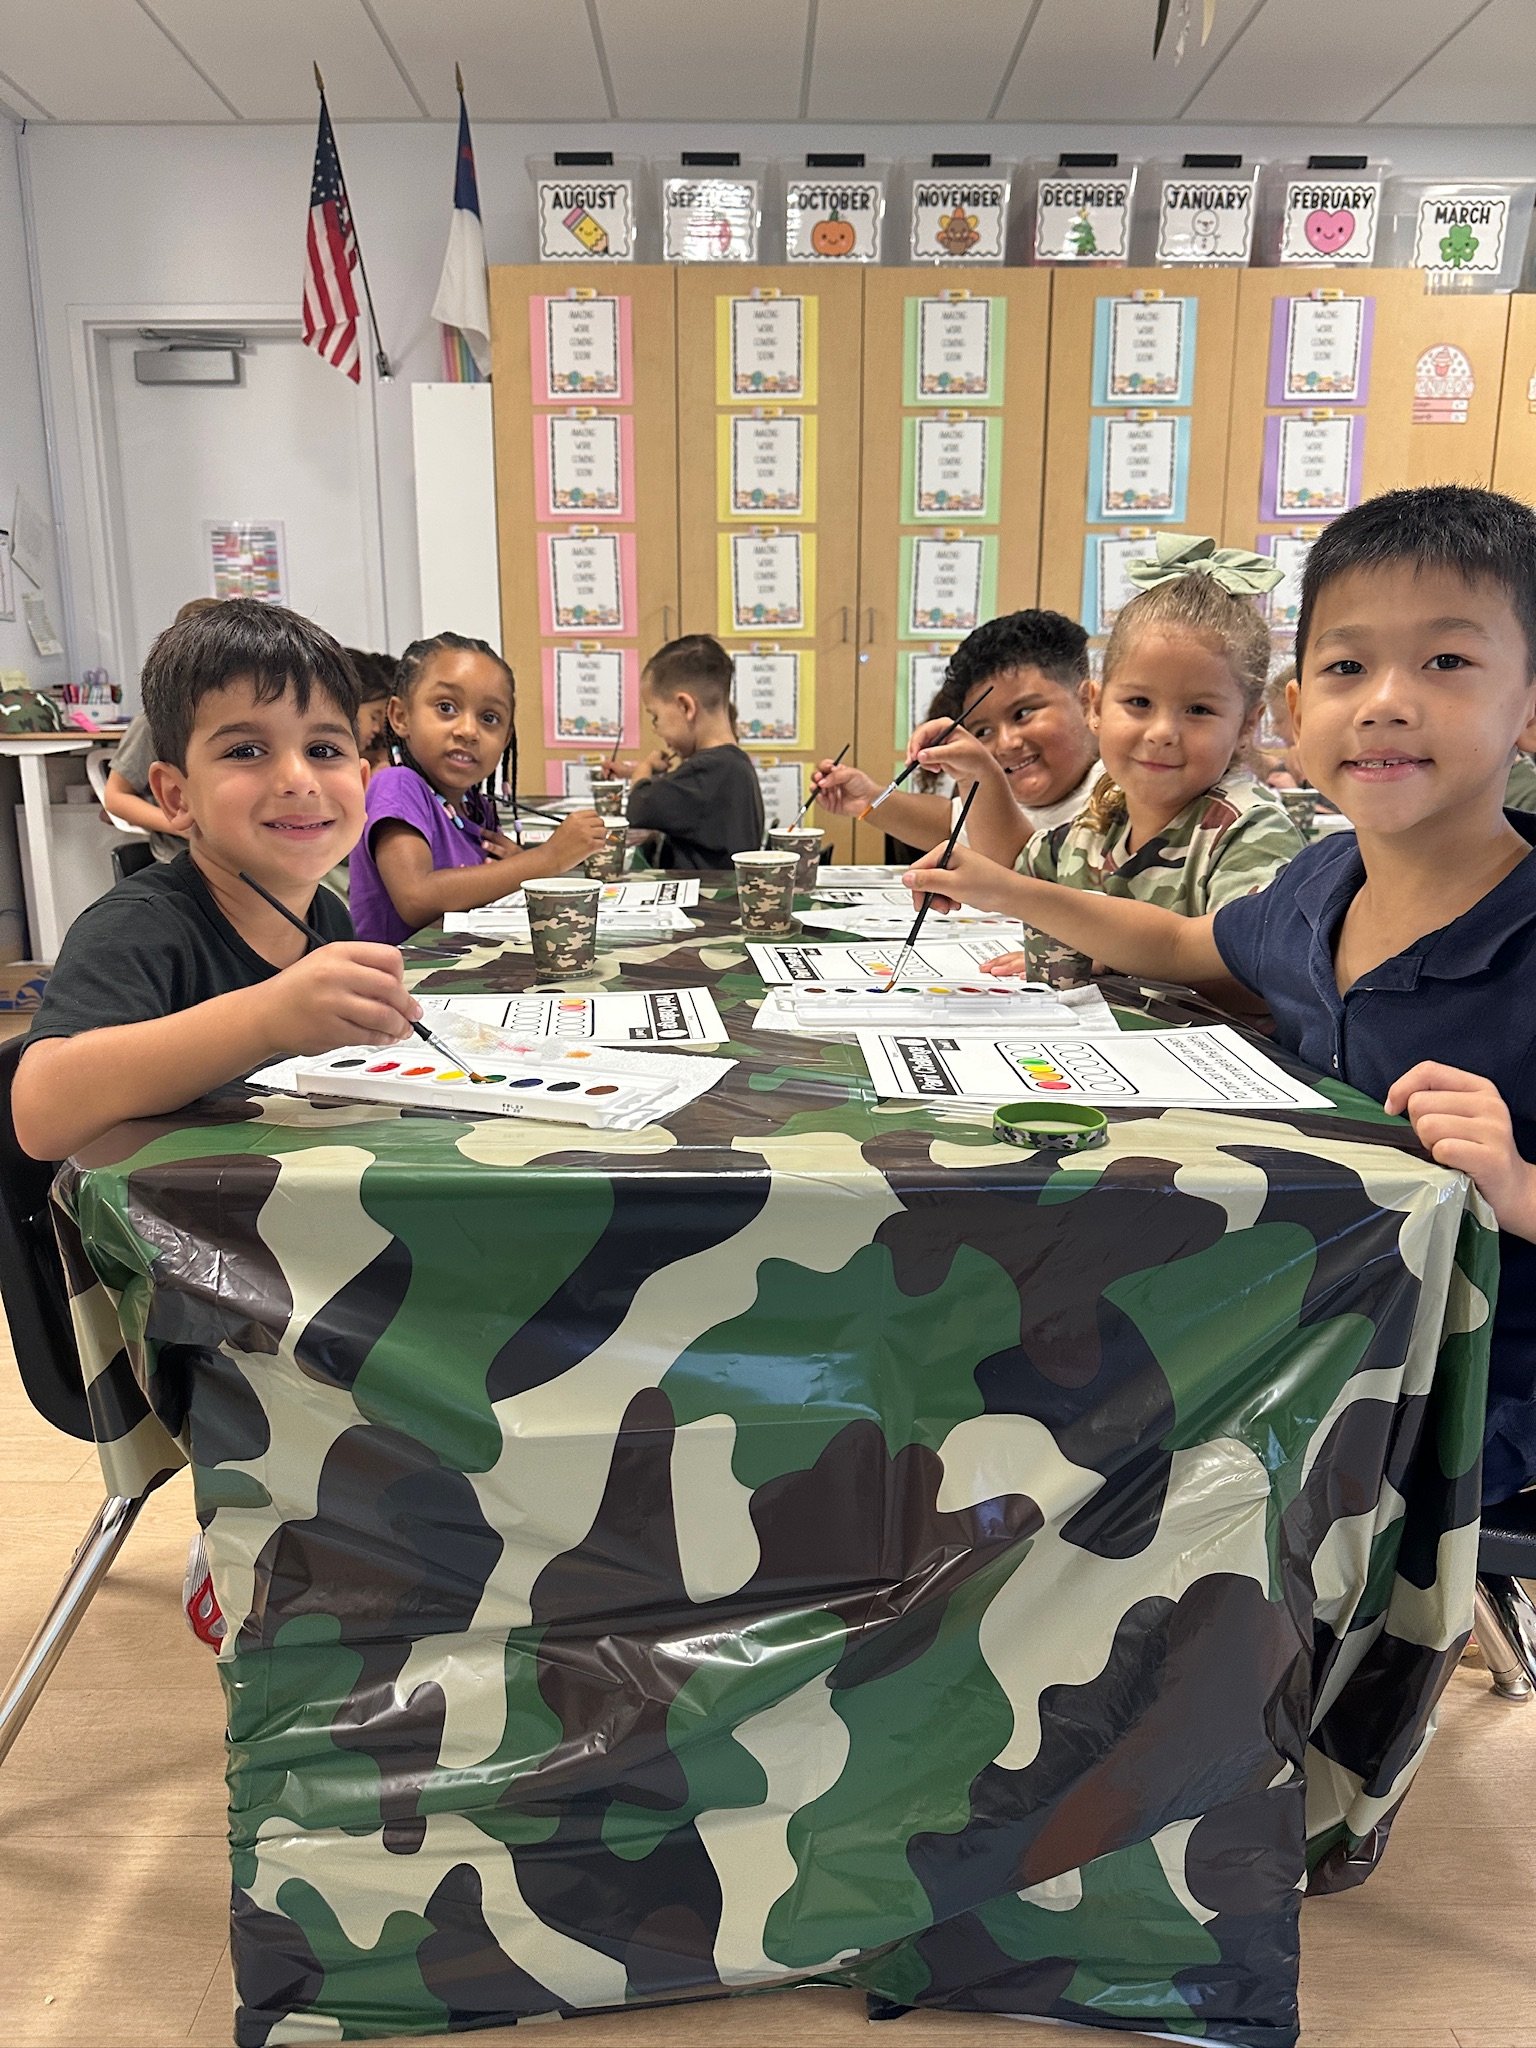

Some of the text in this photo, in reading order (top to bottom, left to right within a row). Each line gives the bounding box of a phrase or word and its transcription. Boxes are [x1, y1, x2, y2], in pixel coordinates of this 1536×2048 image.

[552, 191, 616, 209] AUGUST
[798, 192, 869, 210] OCTOBER
[918, 190, 999, 208] NOVEMBER
[1043, 189, 1124, 207] DECEMBER
[1167, 191, 1248, 209] JANUARY
[1293, 191, 1372, 209] FEBRUARY
[1435, 206, 1491, 225] MARCH
[907, 1046, 937, 1074] Challenge
[915, 1074, 947, 1091] Paint
